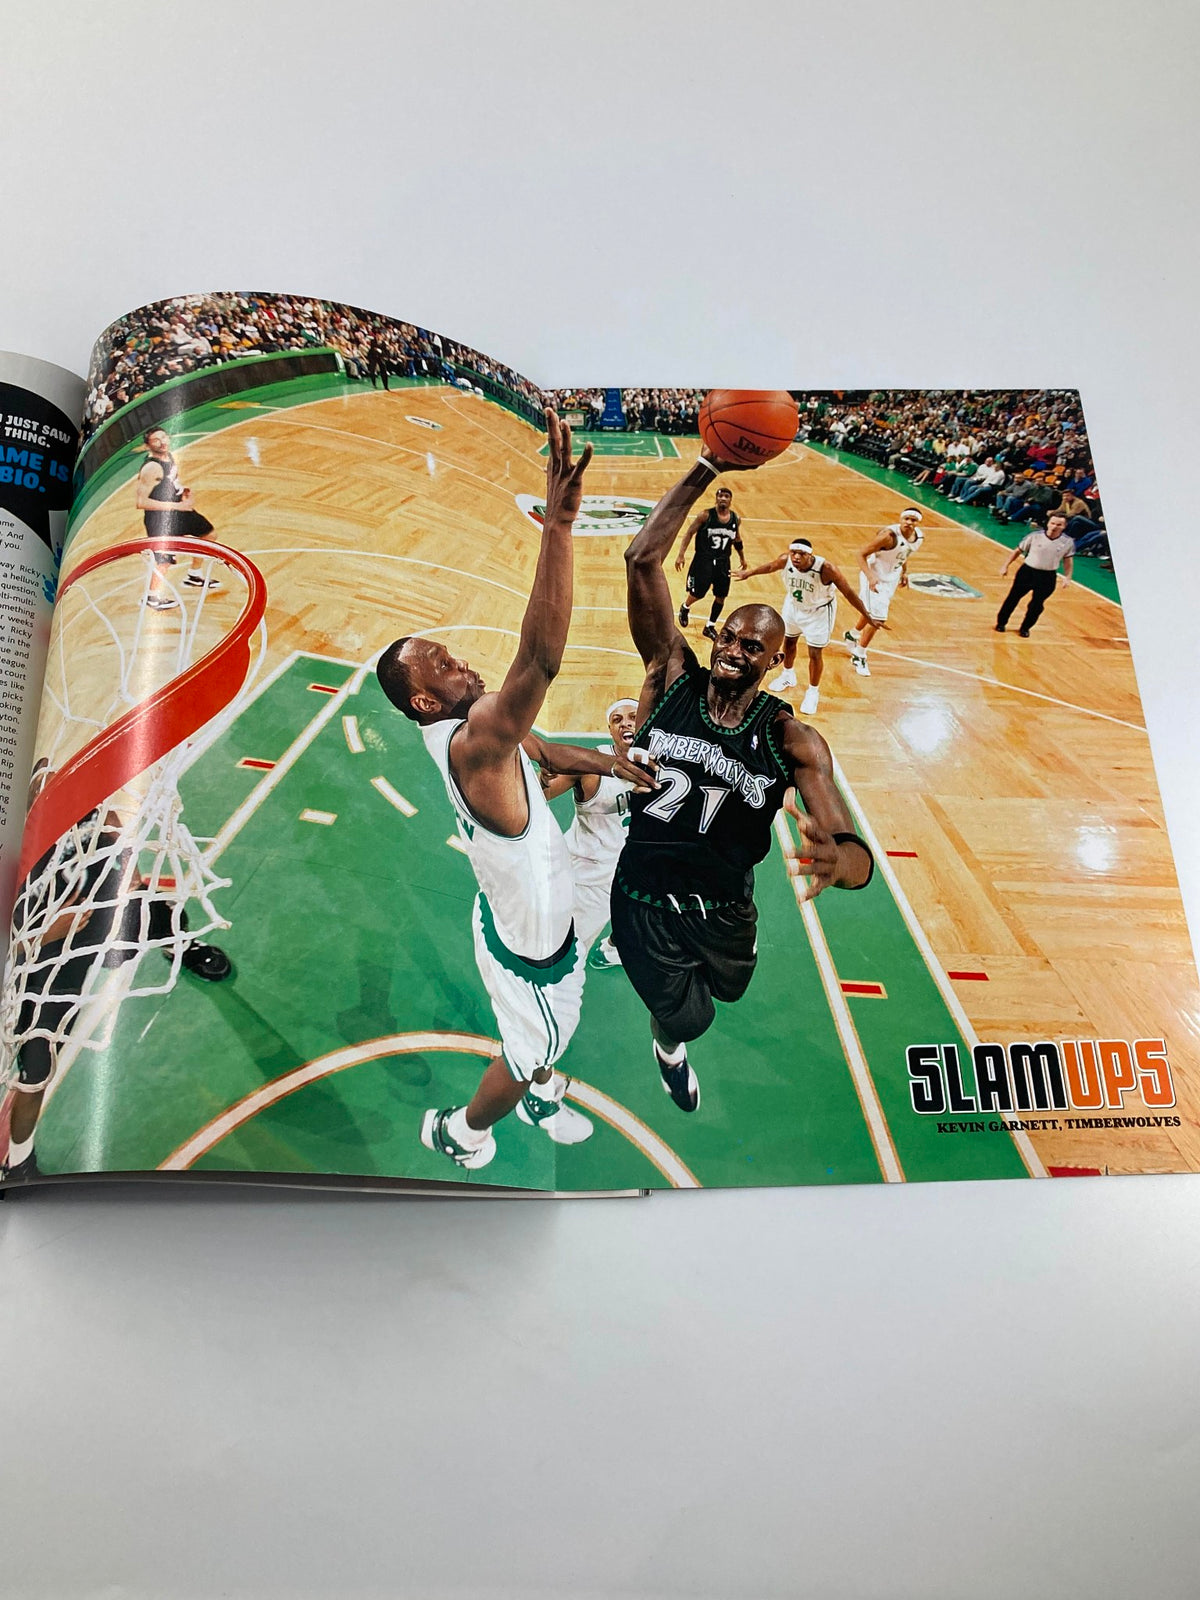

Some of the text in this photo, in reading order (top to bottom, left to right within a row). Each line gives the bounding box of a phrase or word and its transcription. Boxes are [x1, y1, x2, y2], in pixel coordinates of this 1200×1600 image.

[5, 415, 39, 431] JUST
[41, 425, 71, 443] SAW
[4, 426, 51, 448] THING.
[49, 460, 69, 482] IS
[6, 531, 24, 541] And
[711, 535, 730, 550] 31
[4, 541, 22, 551] you.
[20, 565, 41, 579] Ricky
[10, 572, 40, 587] helluva
[0, 591, 37, 606] lti-multi-
[792, 589, 803, 603] 4
[7, 615, 34, 628] weeks
[10, 626, 33, 640] Ricky
[7, 635, 16, 644] in
[17, 639, 31, 649] the
[14, 650, 30, 660] and
[0, 655, 28, 670] eague.
[4, 669, 26, 681] court
[10, 680, 25, 691] like
[2, 691, 24, 702] picks
[1, 758, 15, 769] Rip
[642, 760, 731, 835] 21
[936, 1115, 1182, 1134] KEVIN GARNETT, TIMBERWOLVES
